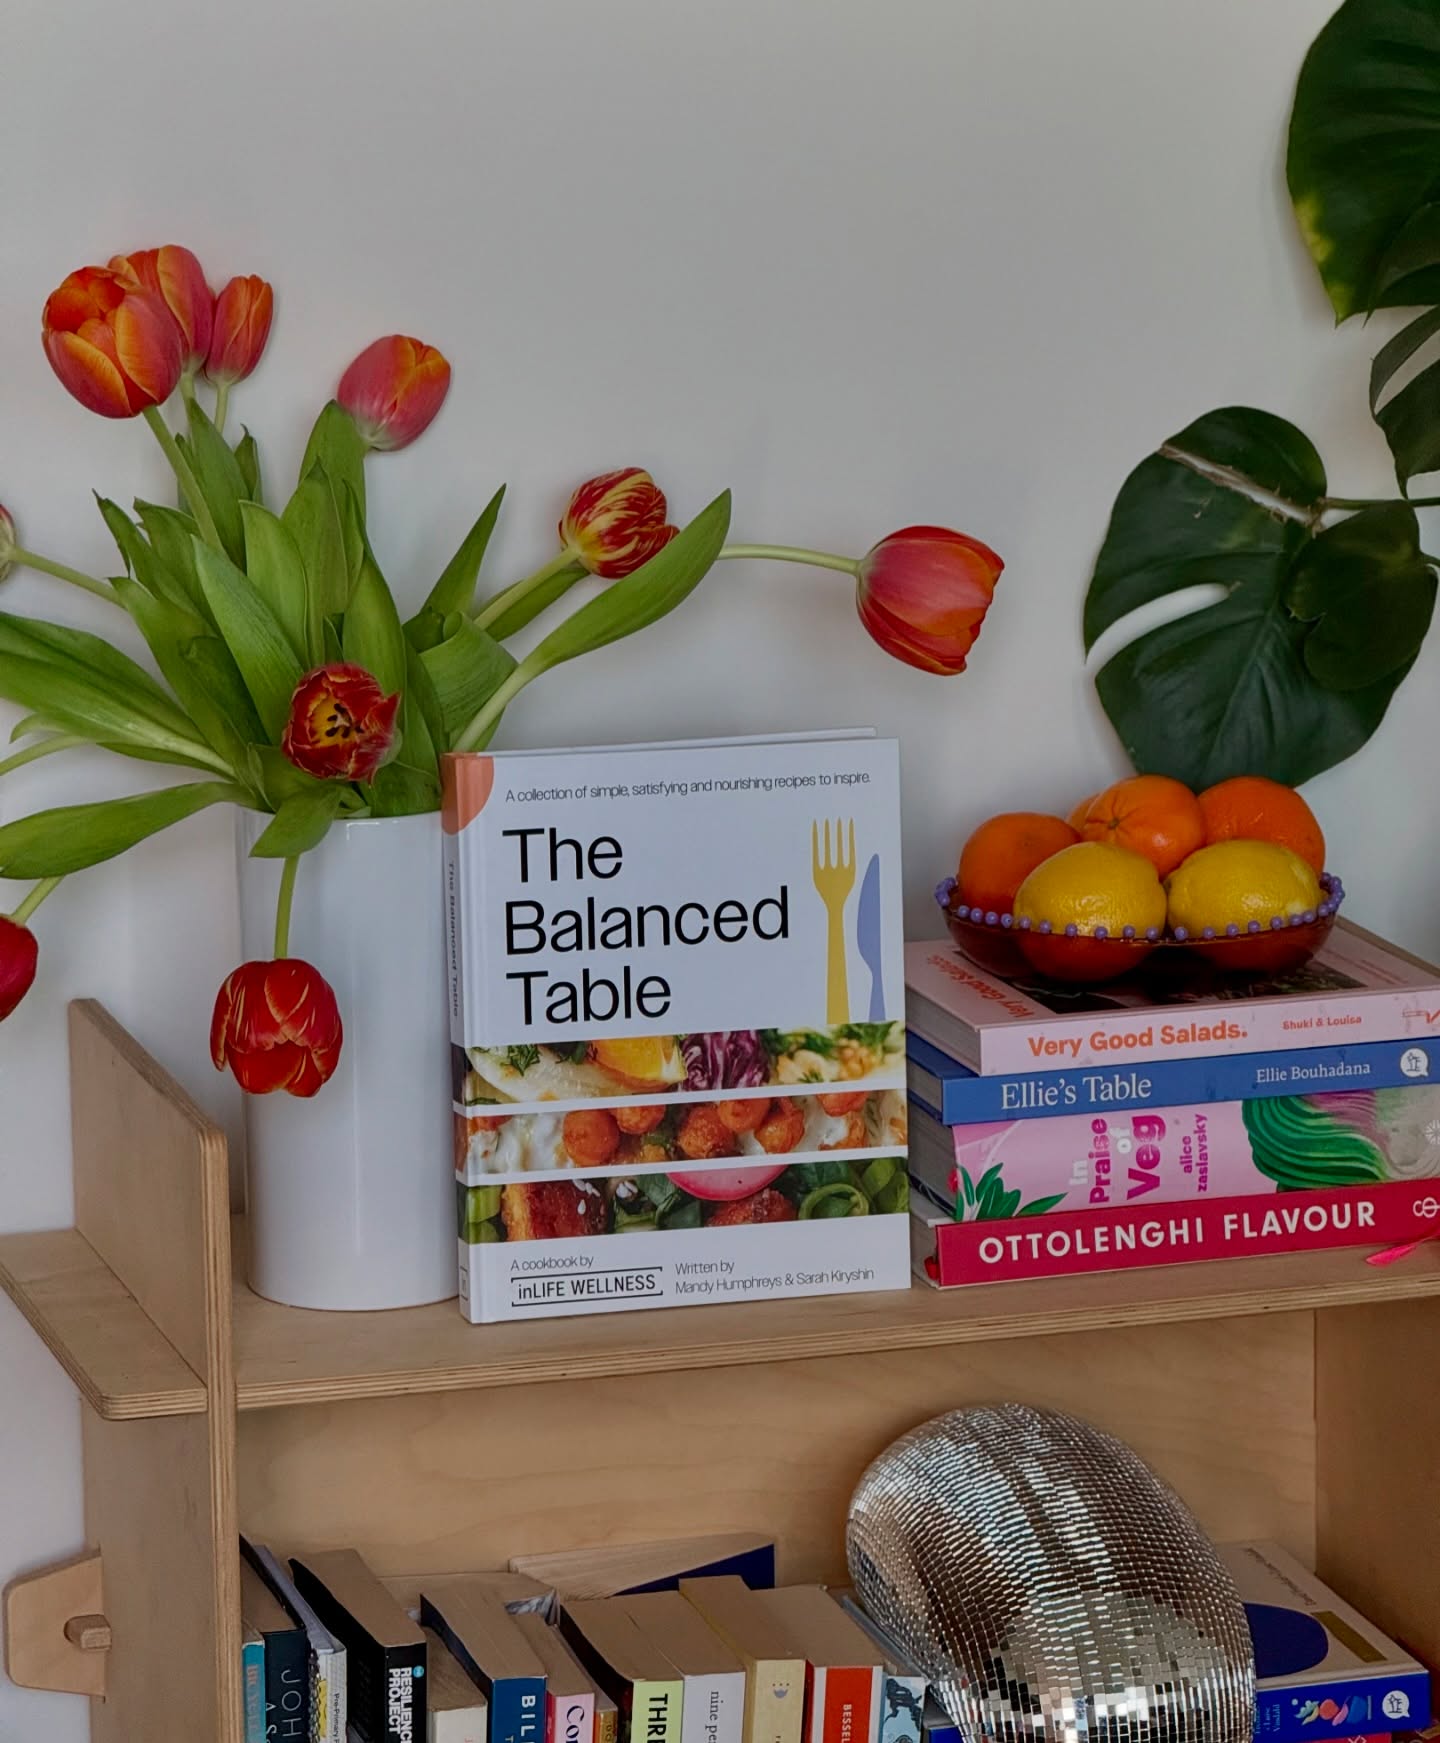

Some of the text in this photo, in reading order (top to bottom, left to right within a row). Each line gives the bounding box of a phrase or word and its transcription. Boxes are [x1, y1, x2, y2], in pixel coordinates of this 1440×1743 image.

[506, 770, 871, 802] A collection of simple, satisfying and nourishing recipes to inspire.
[502, 827, 623, 883] The
[505, 885, 789, 956] Balanced
[505, 965, 672, 1026] Table
[1027, 1020, 1249, 1058] Very Good Salads.
[1282, 1019, 1313, 1030] Shuki
[1315, 1018, 1324, 1027] &
[1082, 1073, 1152, 1102] Table
[1256, 1061, 1371, 1083] Ellie Bouhadana
[1109, 1127, 1132, 1154] of
[1179, 1135, 1193, 1174] alice
[1194, 1113, 1208, 1193] zaslavsky
[1069, 1159, 1089, 1186] In
[1089, 1118, 1111, 1204] Praise
[1126, 1114, 1166, 1200] Veg
[979, 1201, 1376, 1264] OTTOLENGHI FLAVOUR
[511, 1255, 594, 1271] A cookbook by
[675, 1259, 735, 1275] Written by
[518, 1274, 656, 1299] inLIFE WELLNESS
[675, 1267, 875, 1295] Mandy Humphreys & Sarah Kiryshin
[388, 1668, 401, 1735] PROJECT
[709, 1691, 724, 1721] nine
